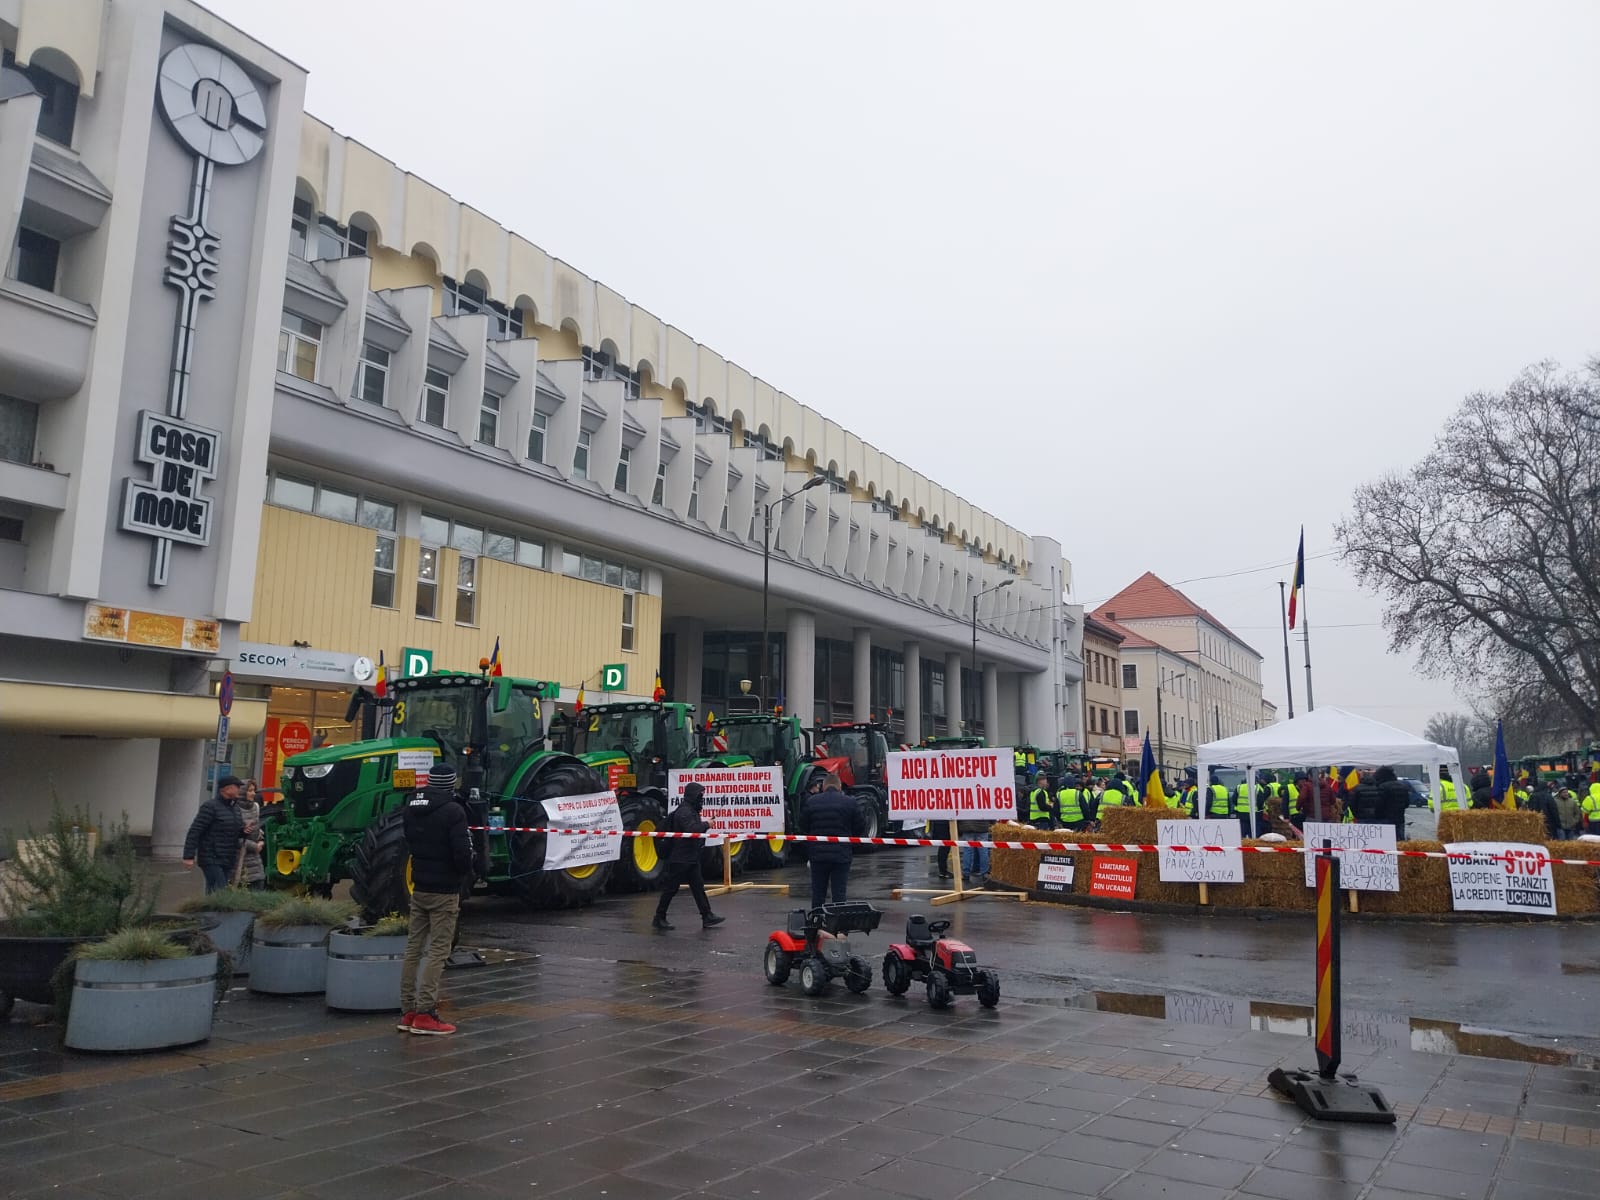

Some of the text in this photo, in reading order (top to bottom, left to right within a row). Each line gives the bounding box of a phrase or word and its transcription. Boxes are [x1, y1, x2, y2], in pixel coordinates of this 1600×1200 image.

[150, 424, 211, 468] CASA
[161, 461, 194, 498] DE
[134, 491, 204, 535] MODE
[240, 652, 286, 666] SECOM
[409, 654, 429, 677] D
[606, 668, 622, 686] D
[394, 702, 406, 725] 3
[532, 697, 541, 720] 3
[588, 714, 600, 732] 2
[901, 753, 997, 779] AICI A ÎNCEPUT
[679, 774, 693, 783] DIN
[738, 771, 771, 781] EUROPEI
[715, 784, 761, 794] BATJOCURA
[762, 784, 773, 792] UE
[890, 784, 1013, 816] DEMOCRAȚIA ÎN 89
[728, 820, 761, 829] NOSTRU
[1306, 823, 1327, 836] NU
[1161, 825, 1224, 845] MUNCA
[1099, 863, 1130, 872] LIMITAREA
[1166, 858, 1205, 869] PAINEA
[1505, 850, 1545, 876] STOP
[1095, 873, 1132, 882] TRANZITULUI
[1452, 872, 1502, 885] EUROPENE
[1506, 876, 1548, 890] TRANZIT
[1105, 884, 1131, 893] UCRAINA
[1454, 889, 1505, 901] LA CREDITE
[1507, 890, 1551, 906] UCRAINA
